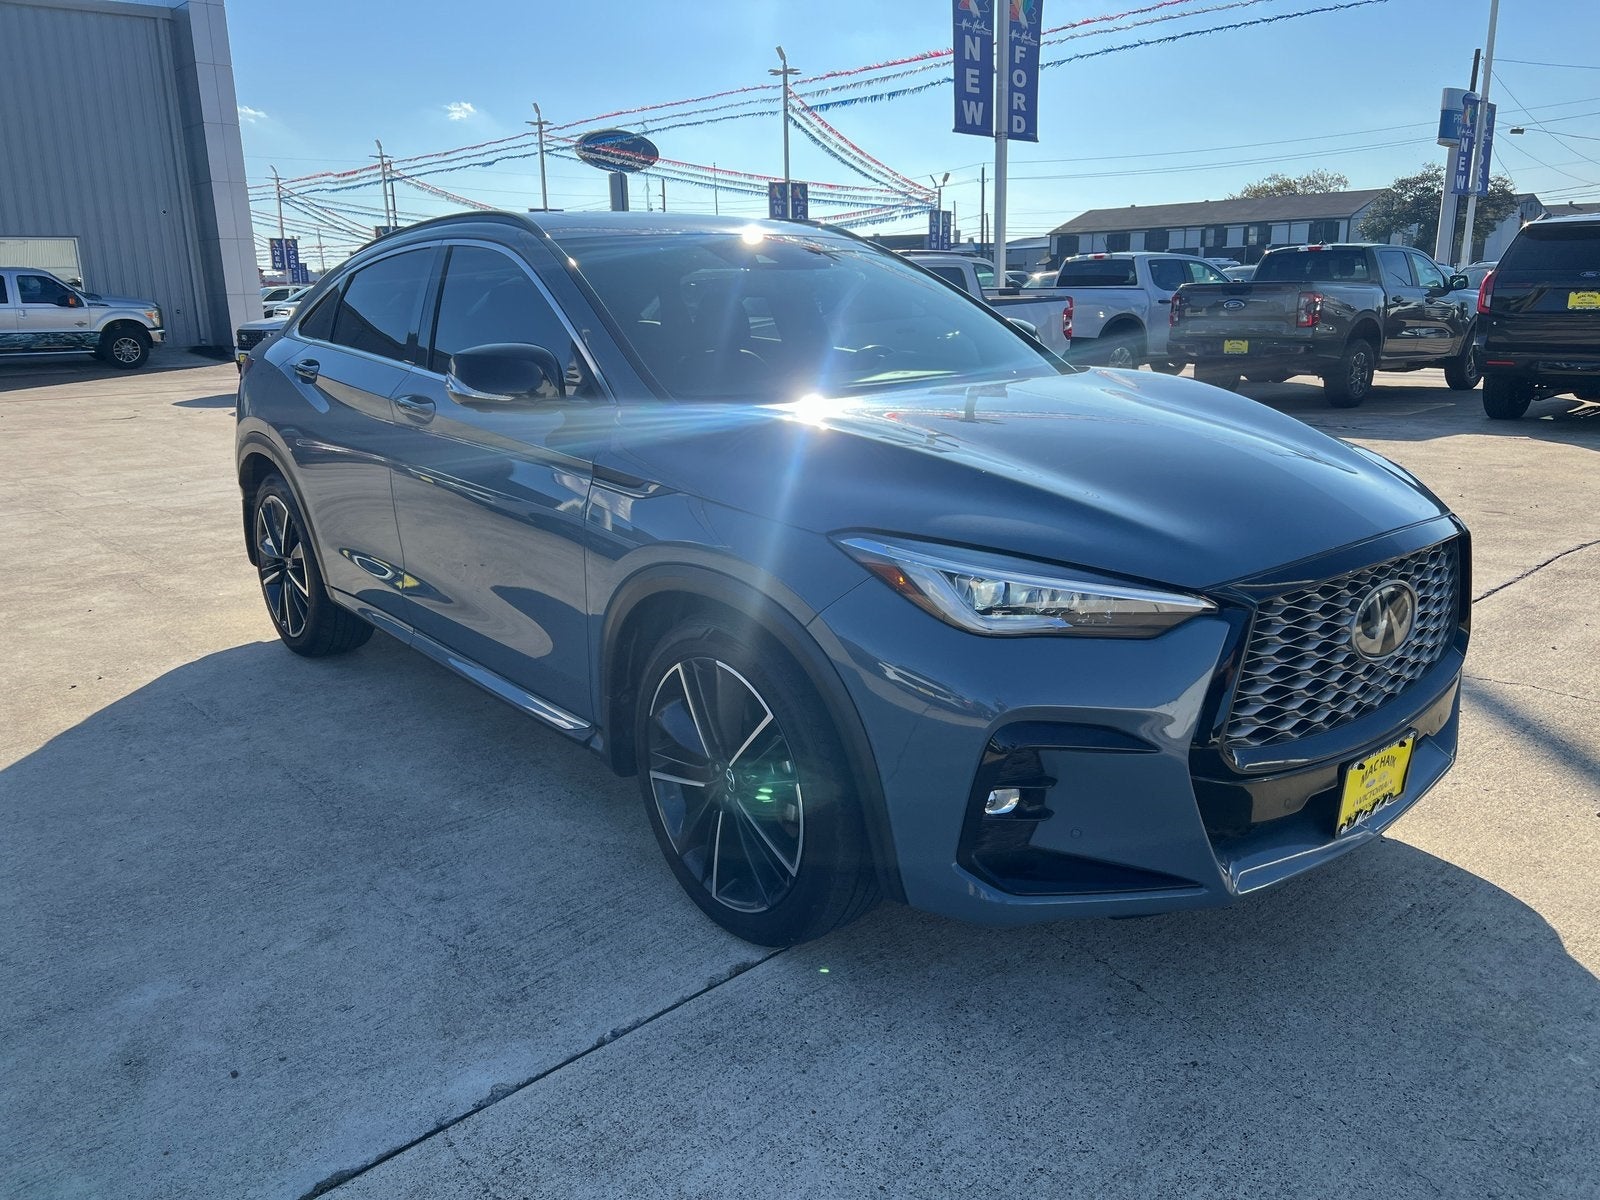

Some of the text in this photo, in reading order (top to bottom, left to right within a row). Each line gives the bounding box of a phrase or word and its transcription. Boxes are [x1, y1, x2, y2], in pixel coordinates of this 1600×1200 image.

[962, 34, 984, 126] NEW
[1012, 45, 1027, 134] FORD
[1456, 137, 1469, 190] NEW
